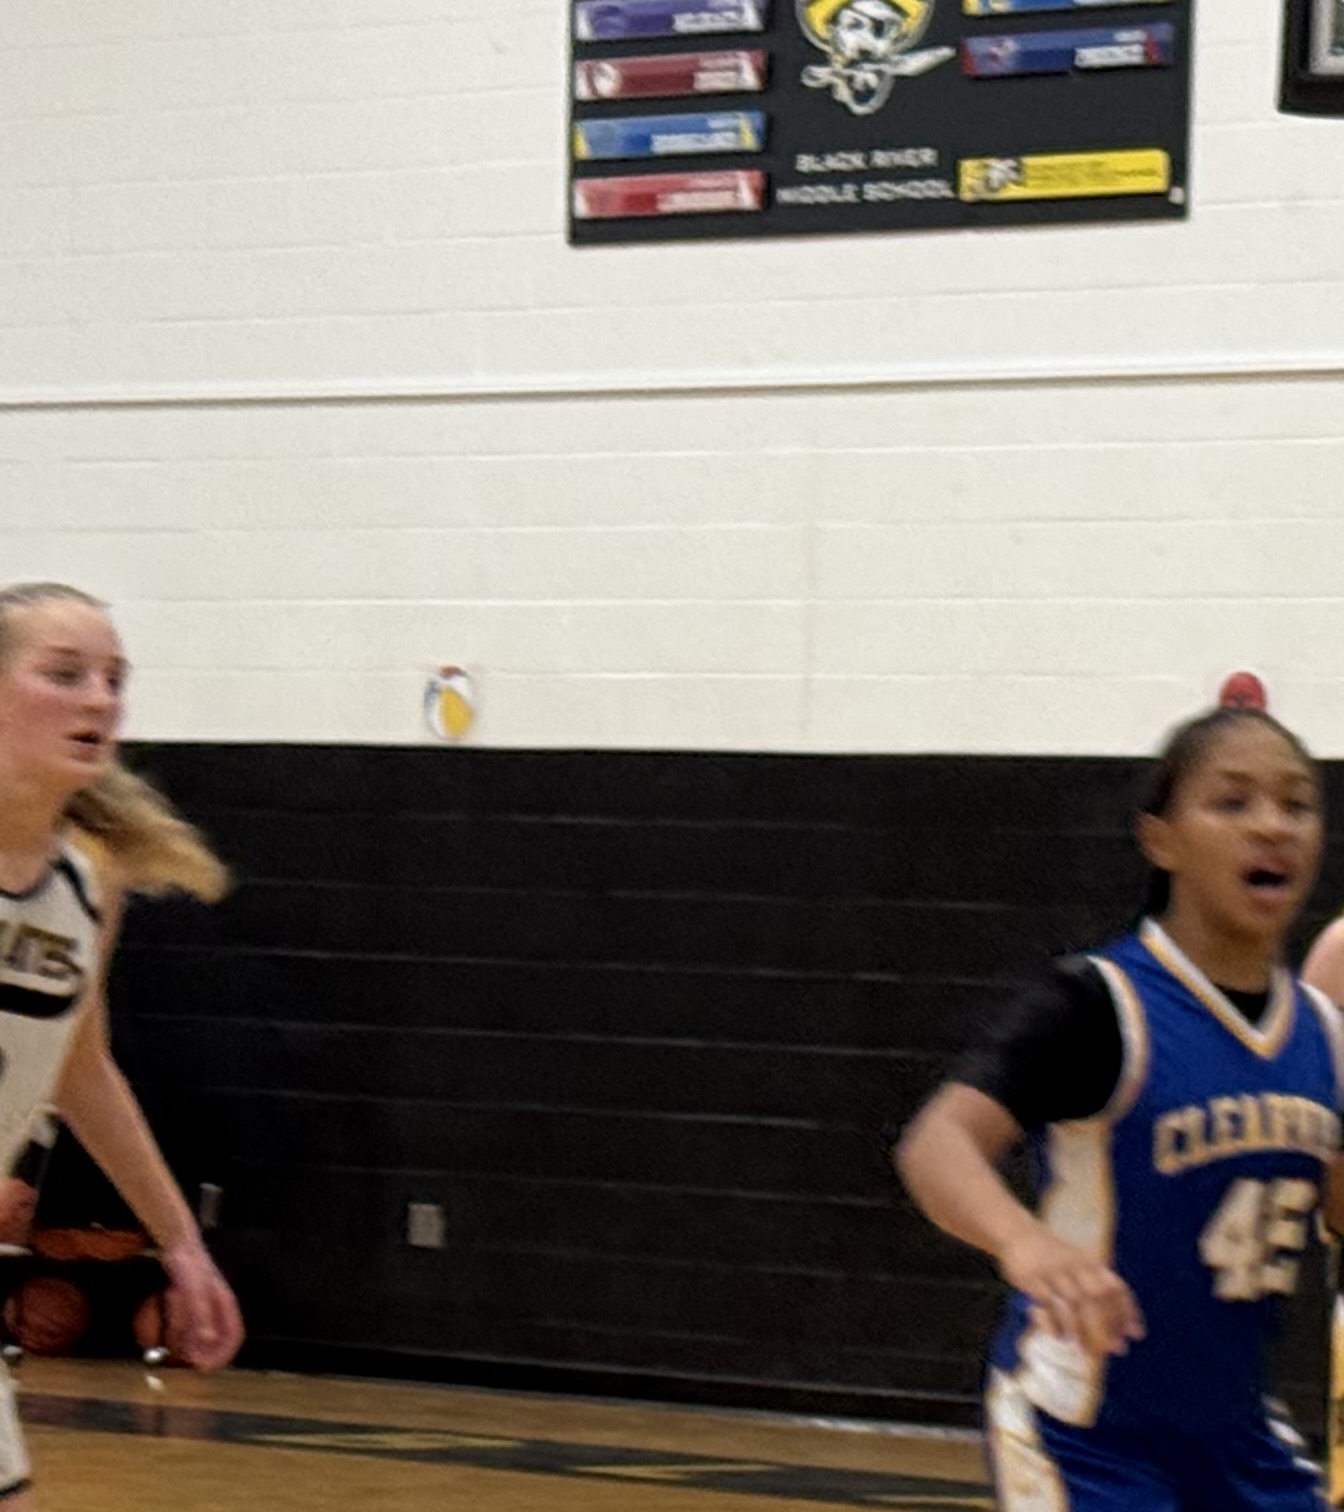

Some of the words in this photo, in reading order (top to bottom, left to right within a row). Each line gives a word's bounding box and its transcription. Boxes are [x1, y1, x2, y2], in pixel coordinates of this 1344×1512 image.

[795, 152, 868, 173] BLACK
[870, 147, 938, 168] RIVER
[775, 183, 861, 205] MIDDLE
[863, 179, 956, 202] SCHOOL
[1197, 1177, 1319, 1302] 45
